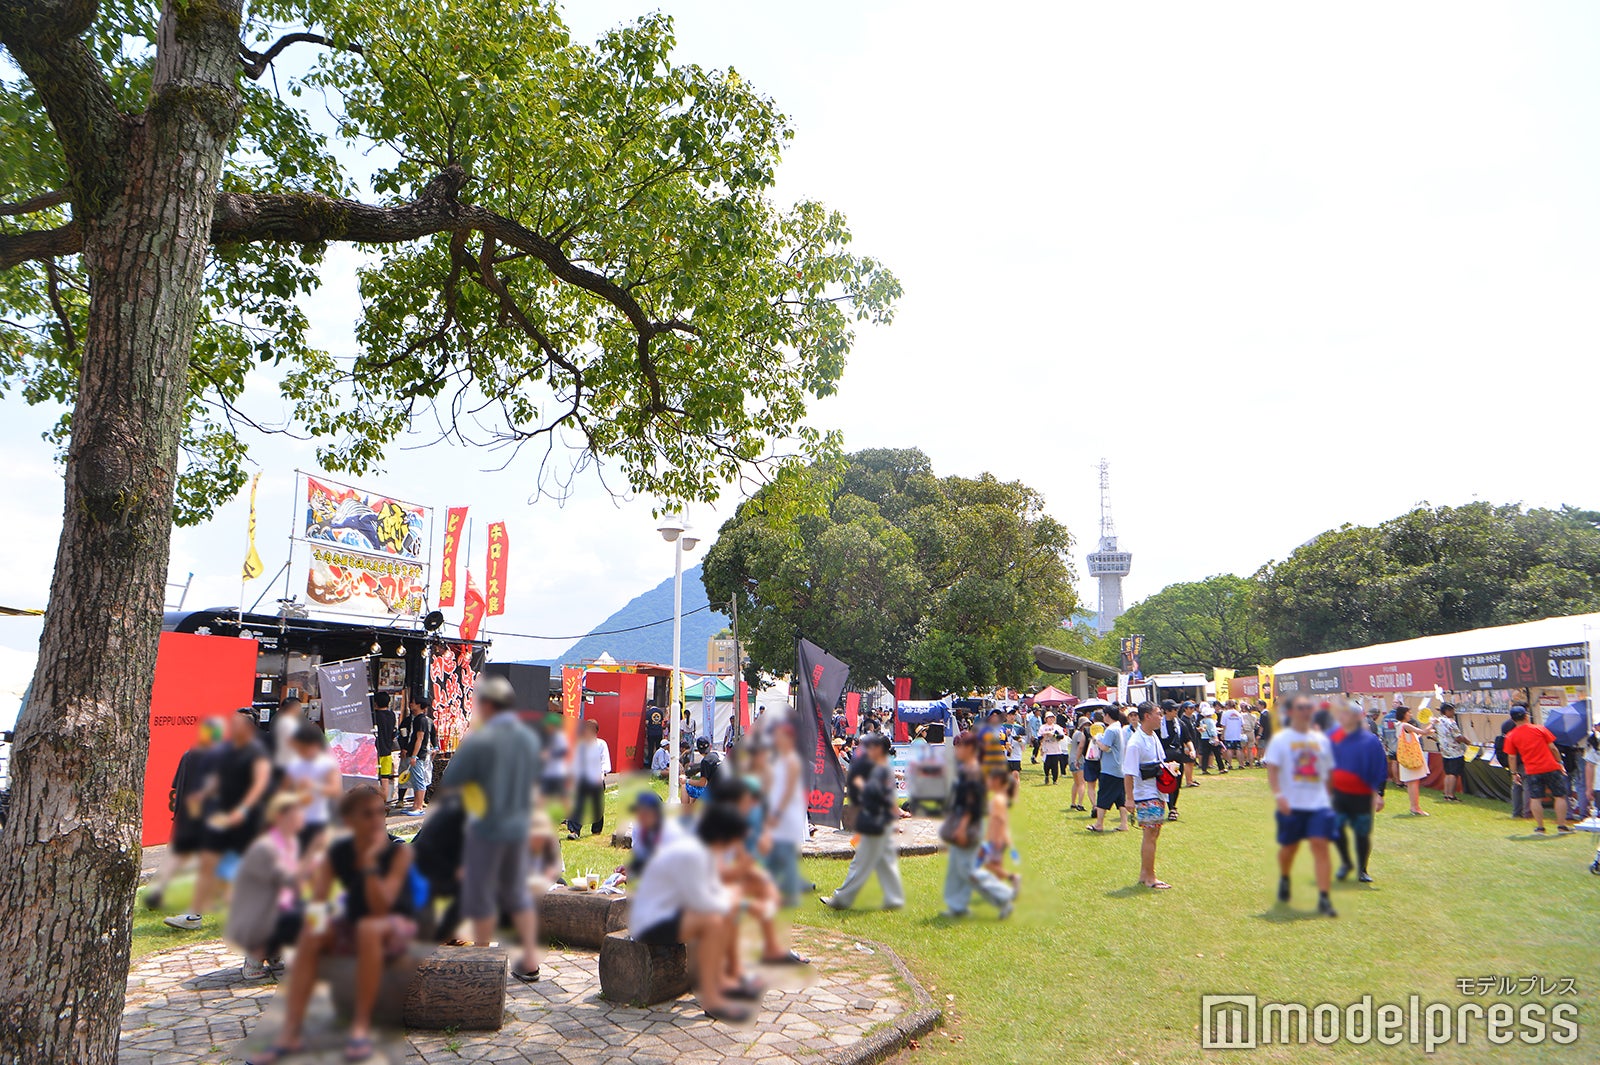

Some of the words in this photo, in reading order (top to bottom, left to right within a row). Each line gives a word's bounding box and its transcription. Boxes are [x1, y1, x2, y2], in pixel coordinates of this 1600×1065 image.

[329, 564, 423, 600] ジビエカレー
[154, 716, 175, 726] BEPPU
[813, 757, 825, 775] FES
